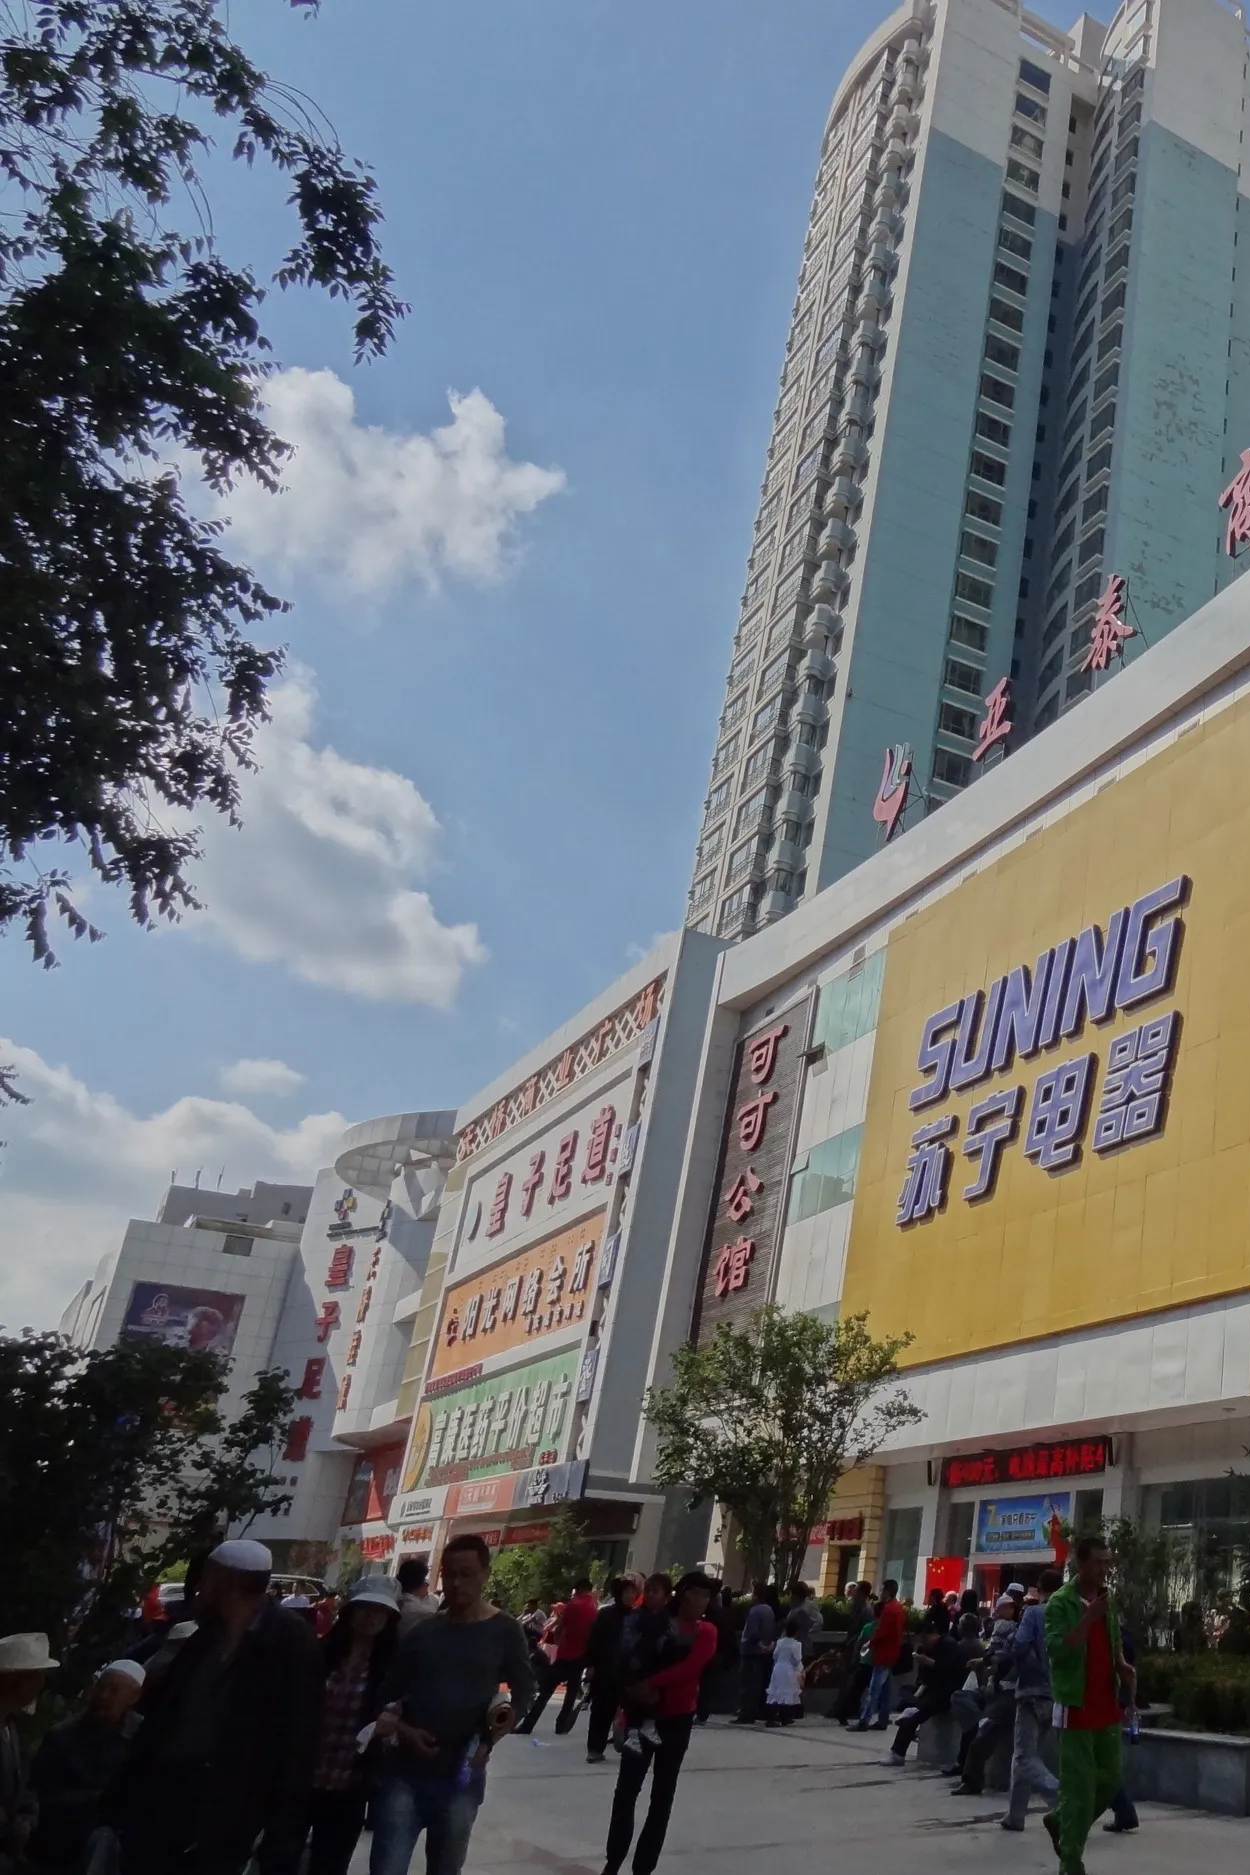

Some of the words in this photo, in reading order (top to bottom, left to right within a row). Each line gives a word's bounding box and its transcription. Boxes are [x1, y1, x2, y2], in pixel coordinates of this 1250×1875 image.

[908, 873, 1193, 1112] SUNING
[484, 1103, 617, 1239] 皇子足道
[713, 1023, 789, 1298] 可可公馆
[896, 1009, 1182, 1227] 苏宁电器
[461, 1239, 595, 1342] 阳光网络会所
